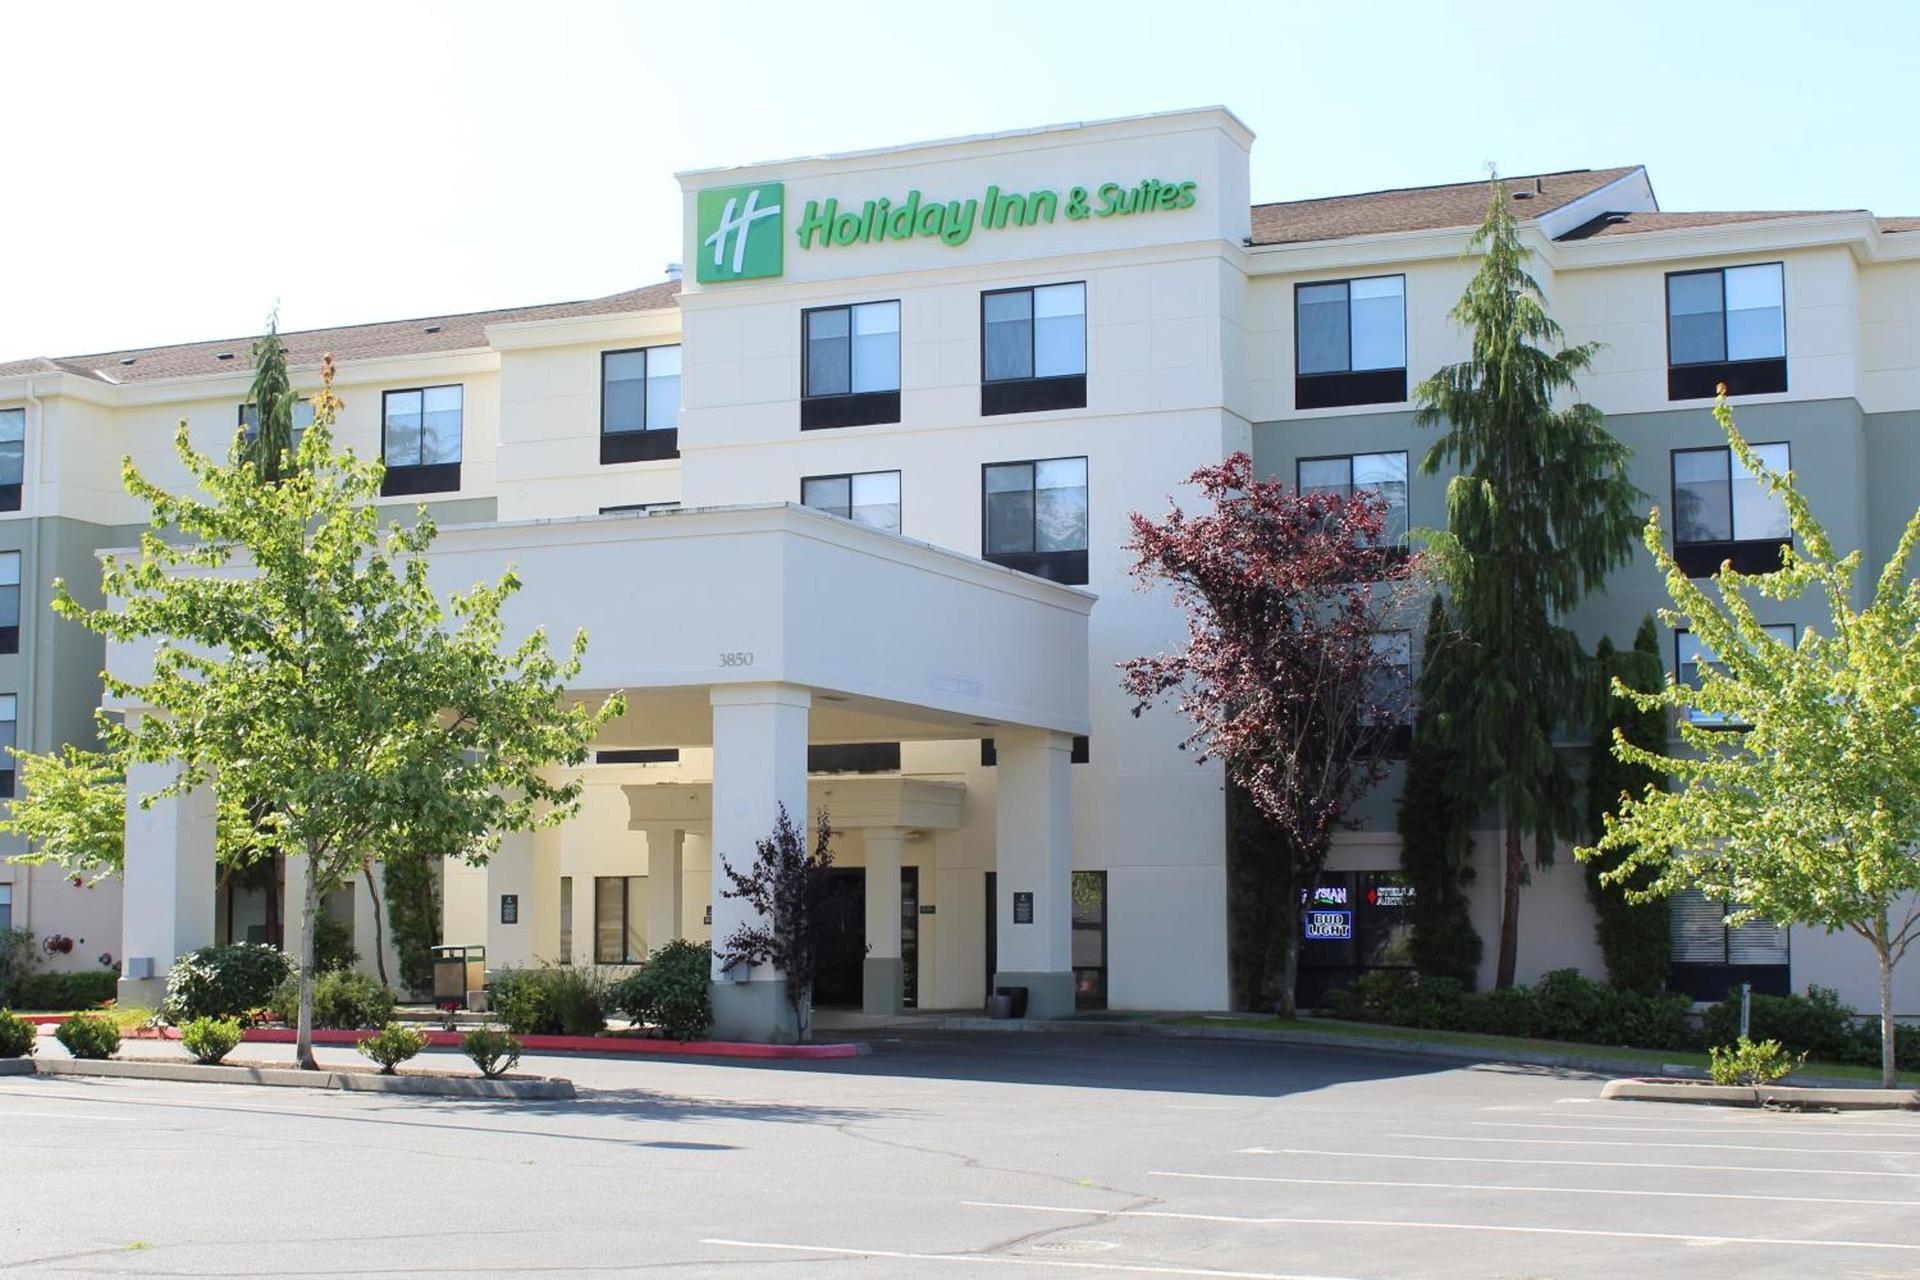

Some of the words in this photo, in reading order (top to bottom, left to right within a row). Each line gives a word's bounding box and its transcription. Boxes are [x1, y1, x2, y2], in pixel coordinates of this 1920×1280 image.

[796, 190, 977, 250] Holiday
[981, 185, 1057, 230] Inn
[1064, 187, 1090, 221] &
[1094, 179, 1197, 219] Suites
[717, 652, 754, 667] 3850
[1377, 887, 1416, 897] STELLA
[1314, 913, 1343, 924] BUD
[1308, 924, 1349, 936] LIGHT
